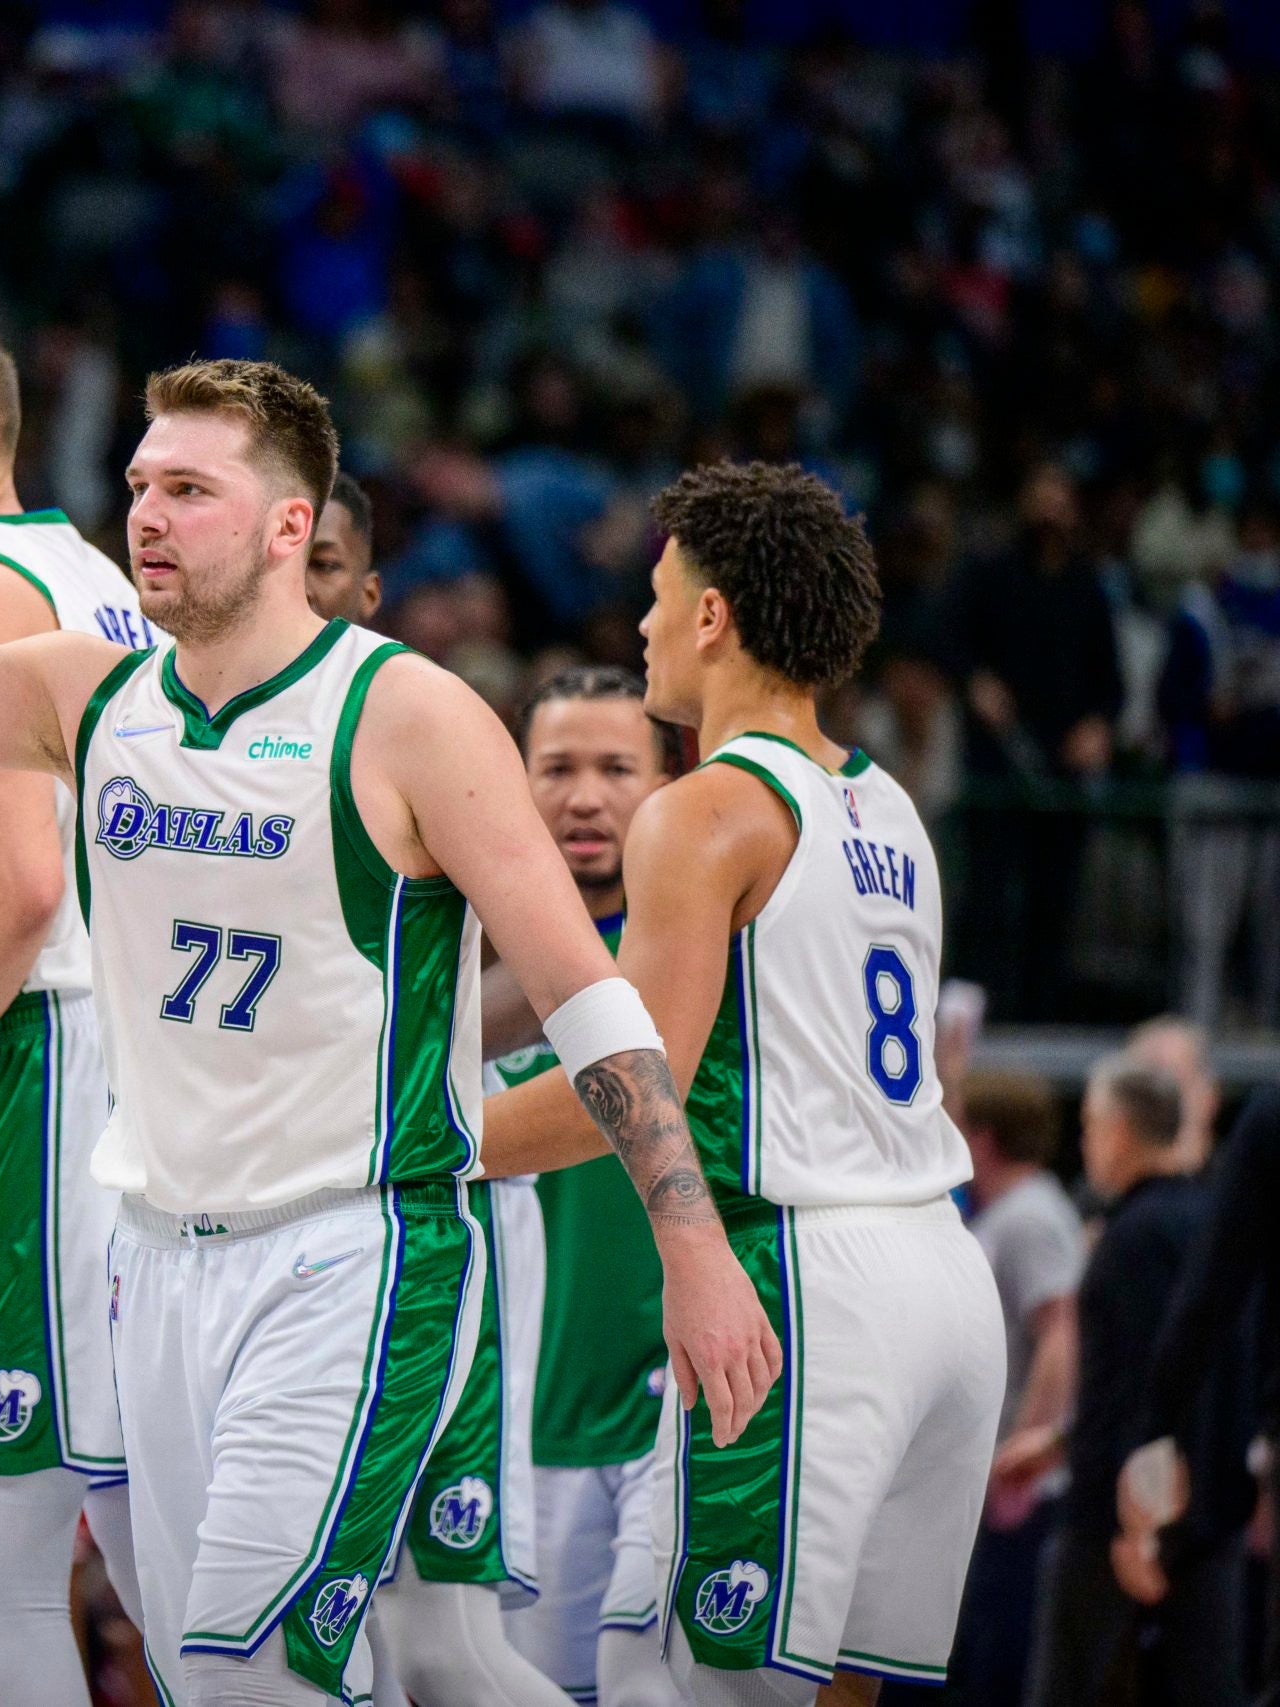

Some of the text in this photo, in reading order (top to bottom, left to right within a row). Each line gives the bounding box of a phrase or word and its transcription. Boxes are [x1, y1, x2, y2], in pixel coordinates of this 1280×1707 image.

[248, 736, 313, 760] chime
[96, 800, 295, 860] DALLAS
[842, 838, 916, 912] GREEN
[160, 919, 282, 1032] 77
[862, 943, 923, 1107] 8
[694, 1580, 754, 1620] M
